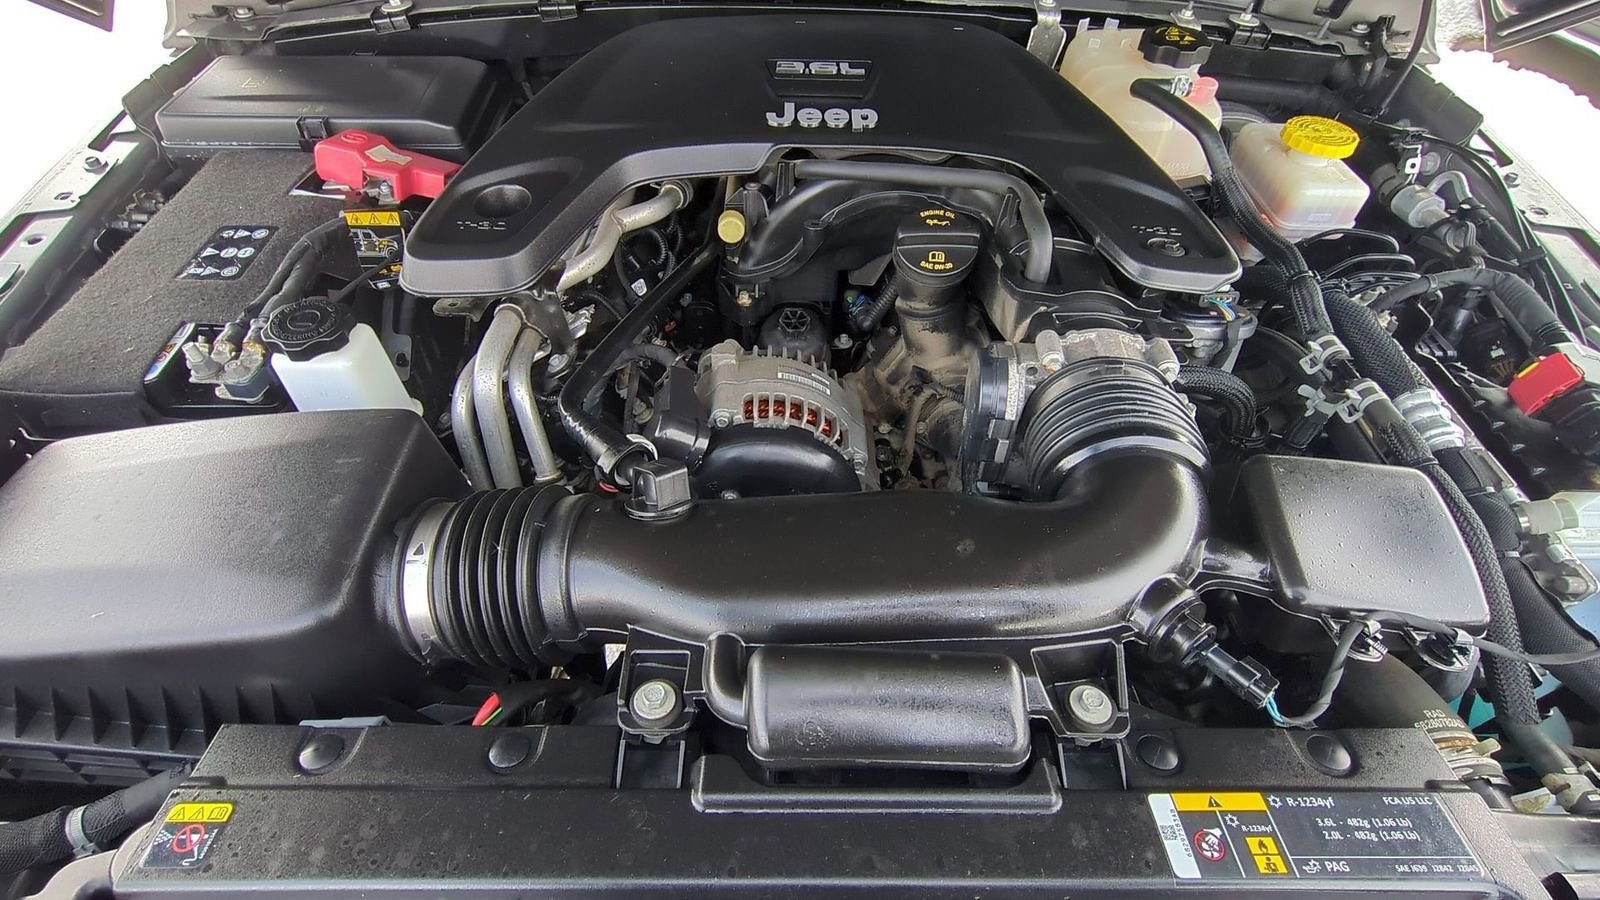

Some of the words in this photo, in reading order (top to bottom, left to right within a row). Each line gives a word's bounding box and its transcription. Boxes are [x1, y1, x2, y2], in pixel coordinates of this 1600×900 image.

[775, 61, 866, 75] 3.6L
[766, 102, 879, 132] Jeep
[919, 209, 944, 218] ENGINE
[945, 210, 955, 219] OIL
[920, 260, 934, 270] SAE
[1423, 709, 1446, 719] RAD
[1286, 796, 1335, 809] R-1234yf
[1382, 796, 1402, 805] FCA
[1402, 796, 1416, 805] US
[1416, 796, 1433, 805] LLC
[1315, 818, 1337, 827] 3.6L
[1347, 818, 1371, 829] 482g
[1371, 818, 1396, 828] (1.06
[1322, 831, 1344, 840] 2.0L
[1354, 831, 1378, 842] 482g
[1378, 830, 1404, 841] (1.06
[1324, 861, 1351, 872] PAG
[1394, 864, 1411, 873] SAE
